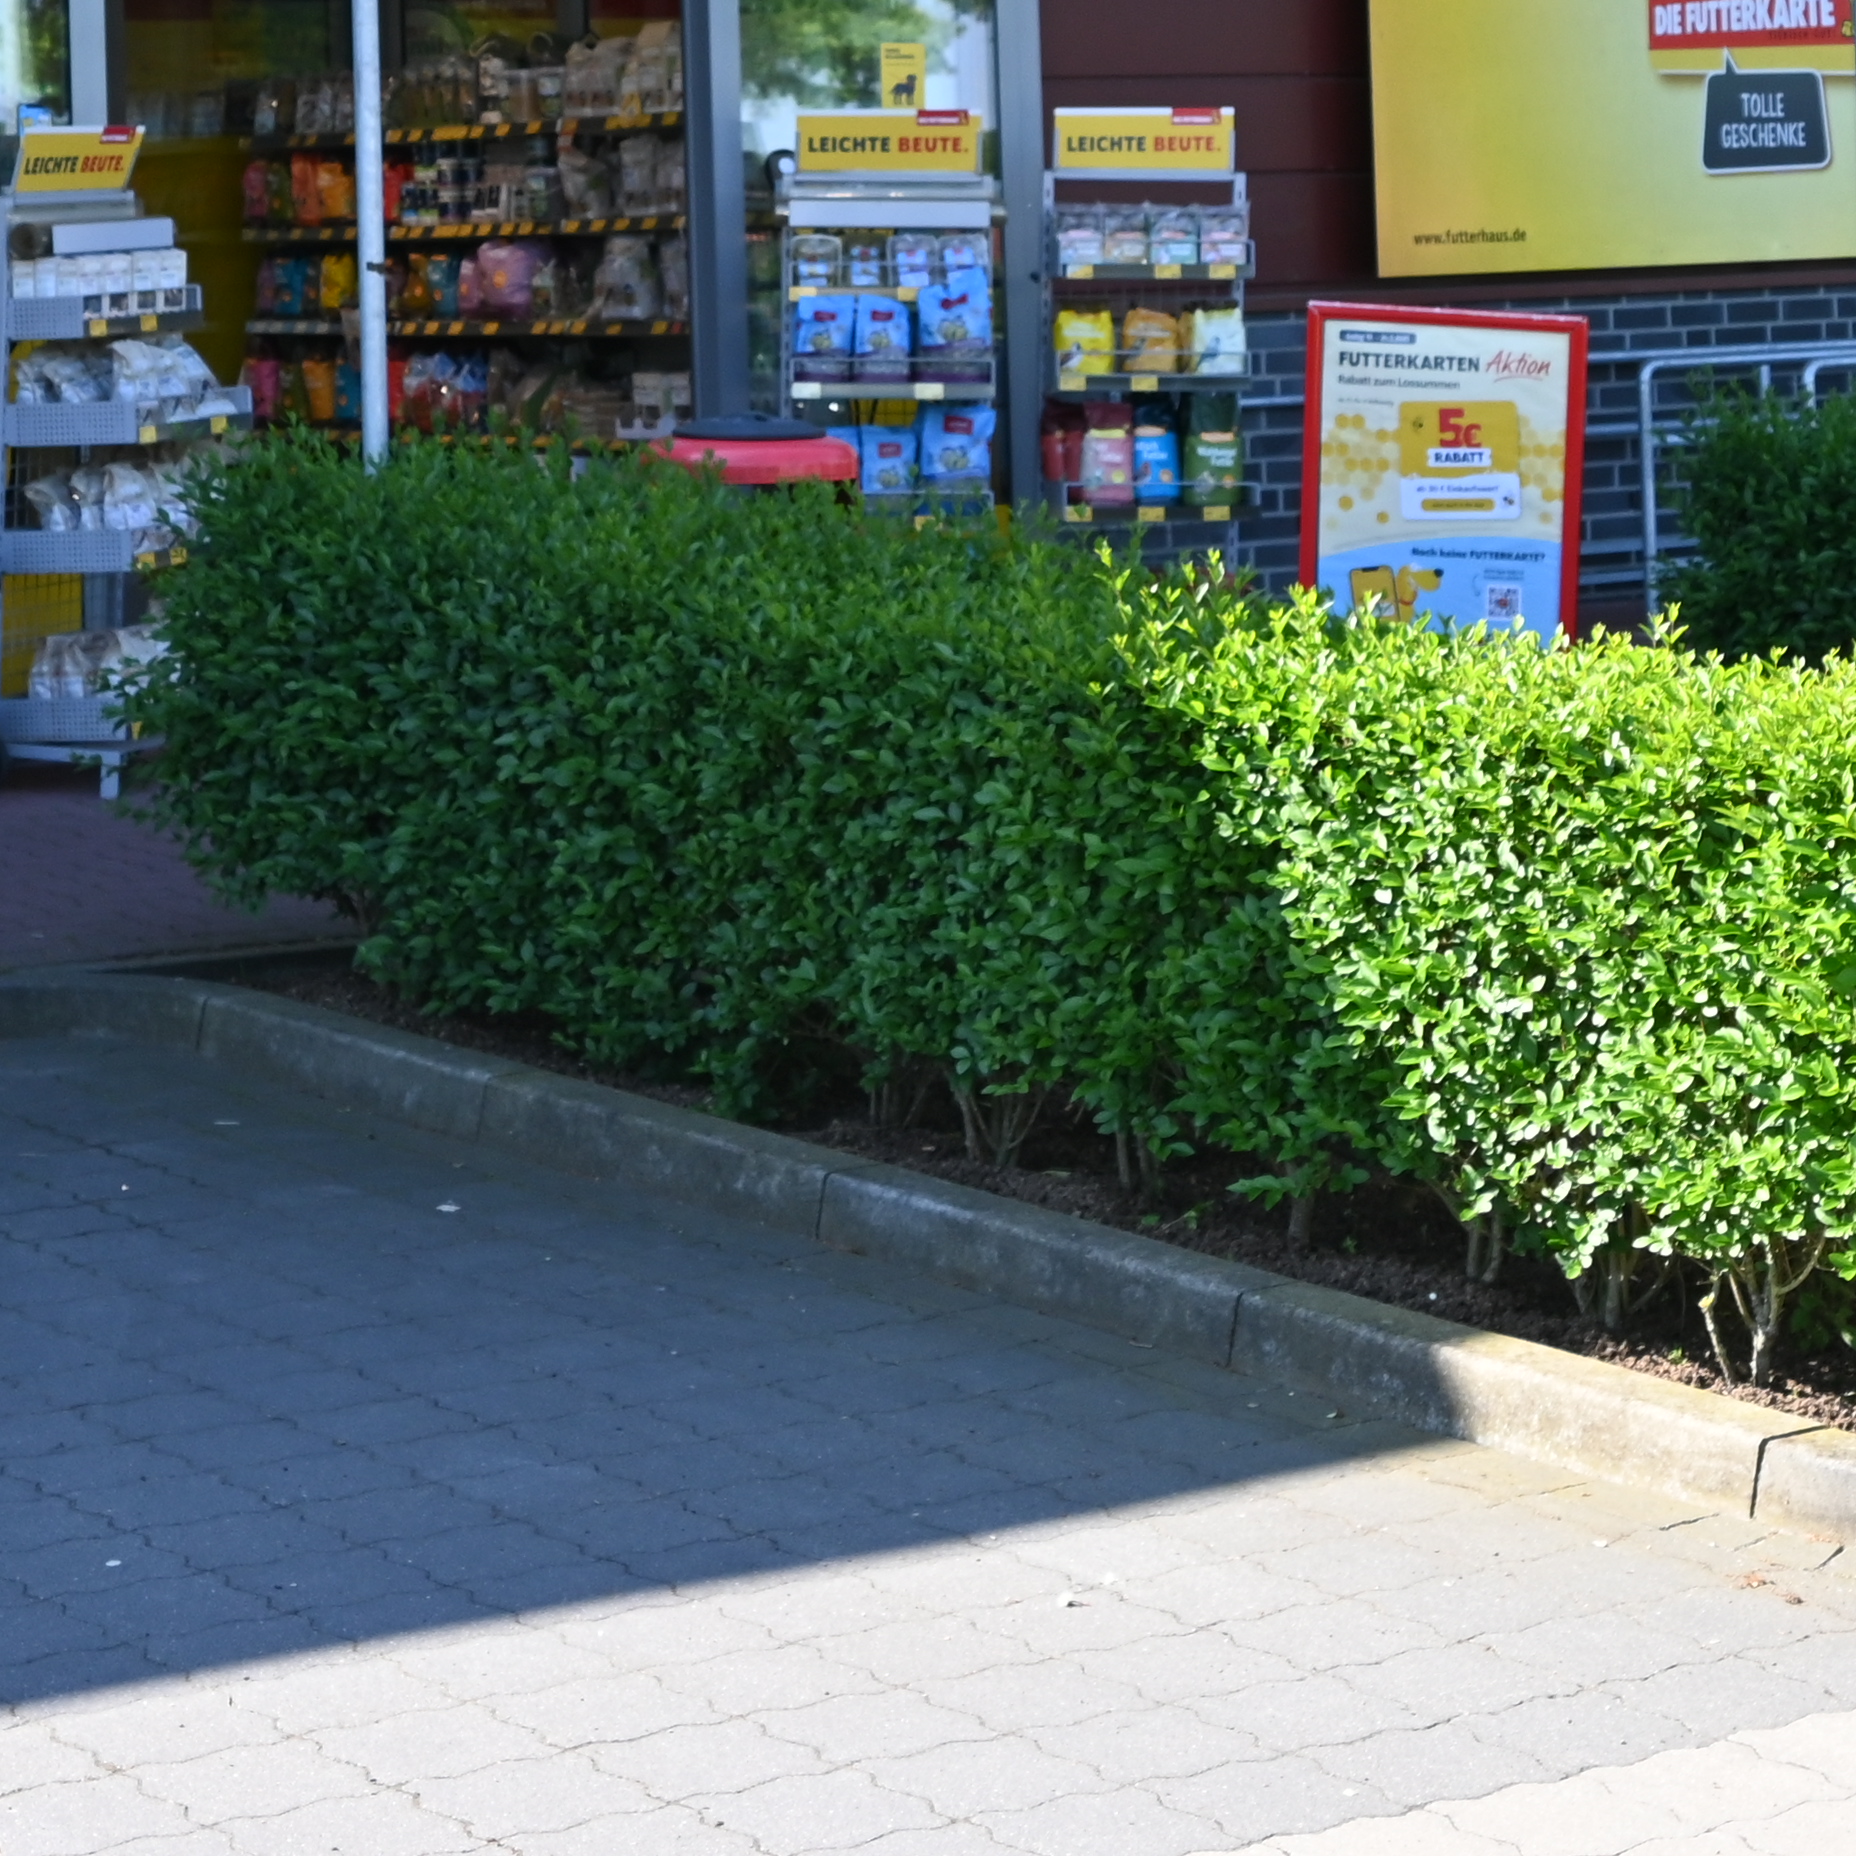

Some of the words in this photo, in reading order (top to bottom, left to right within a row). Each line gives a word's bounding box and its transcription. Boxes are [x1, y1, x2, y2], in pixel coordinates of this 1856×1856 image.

[1655, 3, 1682, 35] DIE
[1741, 93, 1785, 118] TOLLE
[807, 136, 891, 153] LEICHTE
[897, 137, 969, 153] BEUTE.
[1066, 136, 1147, 152] LEICHTE
[1153, 136, 1221, 153] BEUTE.
[1721, 122, 1806, 148] GESCHENKE
[24, 155, 79, 176] LEICHTE
[80, 155, 124, 174] BEUTE.
[1413, 228, 1527, 245] www.futterhaus.de
[1339, 351, 1480, 373] FUTTERKARTEN
[1485, 350, 1552, 376] Aktion
[1434, 452, 1484, 464] RABATT
